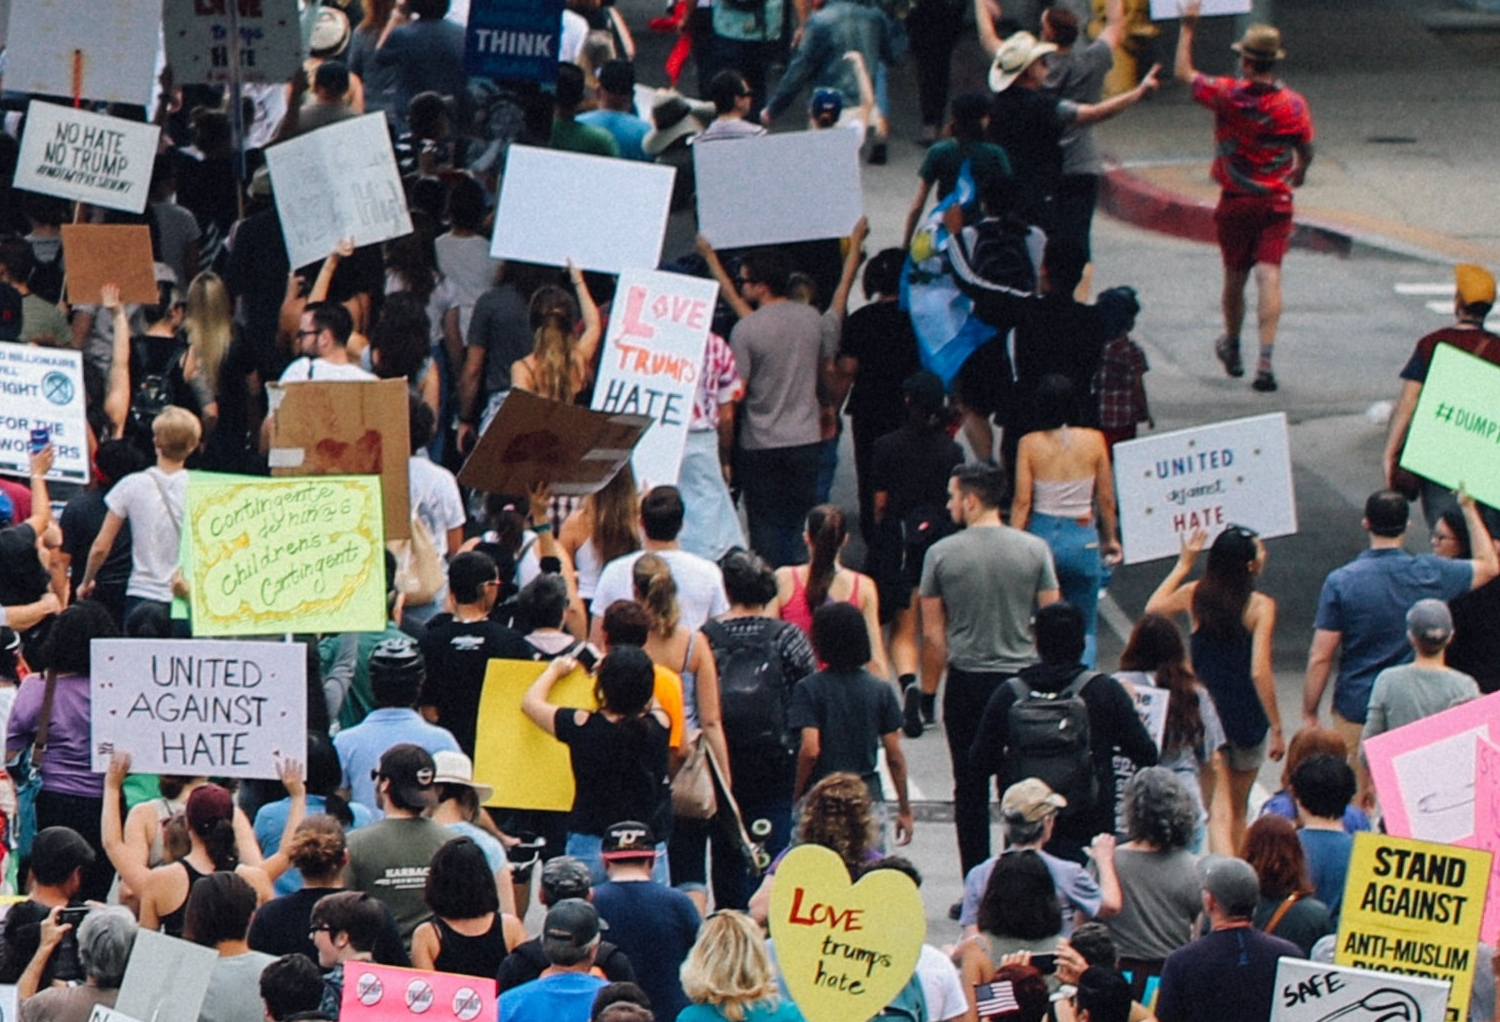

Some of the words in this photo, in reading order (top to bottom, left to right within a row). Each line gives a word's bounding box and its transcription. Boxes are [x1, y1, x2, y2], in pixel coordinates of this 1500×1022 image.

[476, 28, 553, 58] THINK
[56, 122, 81, 145] NO
[82, 126, 126, 152] HATE
[44, 143, 68, 164] NO
[71, 147, 127, 175] TRUMP
[622, 285, 707, 338] LOVE
[602, 379, 683, 425] HATE
[1156, 449, 1233, 479] UNITED
[1173, 506, 1226, 532] HATE
[151, 655, 263, 689] UNITED
[128, 692, 268, 728] AGAINST
[161, 731, 249, 768] HATE
[1373, 846, 1466, 888] STAND
[789, 887, 864, 932] LOVE
[1361, 882, 1467, 924] AGAINST
[820, 934, 892, 967] trumps
[1344, 931, 1468, 970] ANTI-MUSLIM
[814, 961, 866, 995] hate
[1283, 971, 1347, 1007] SAFE
